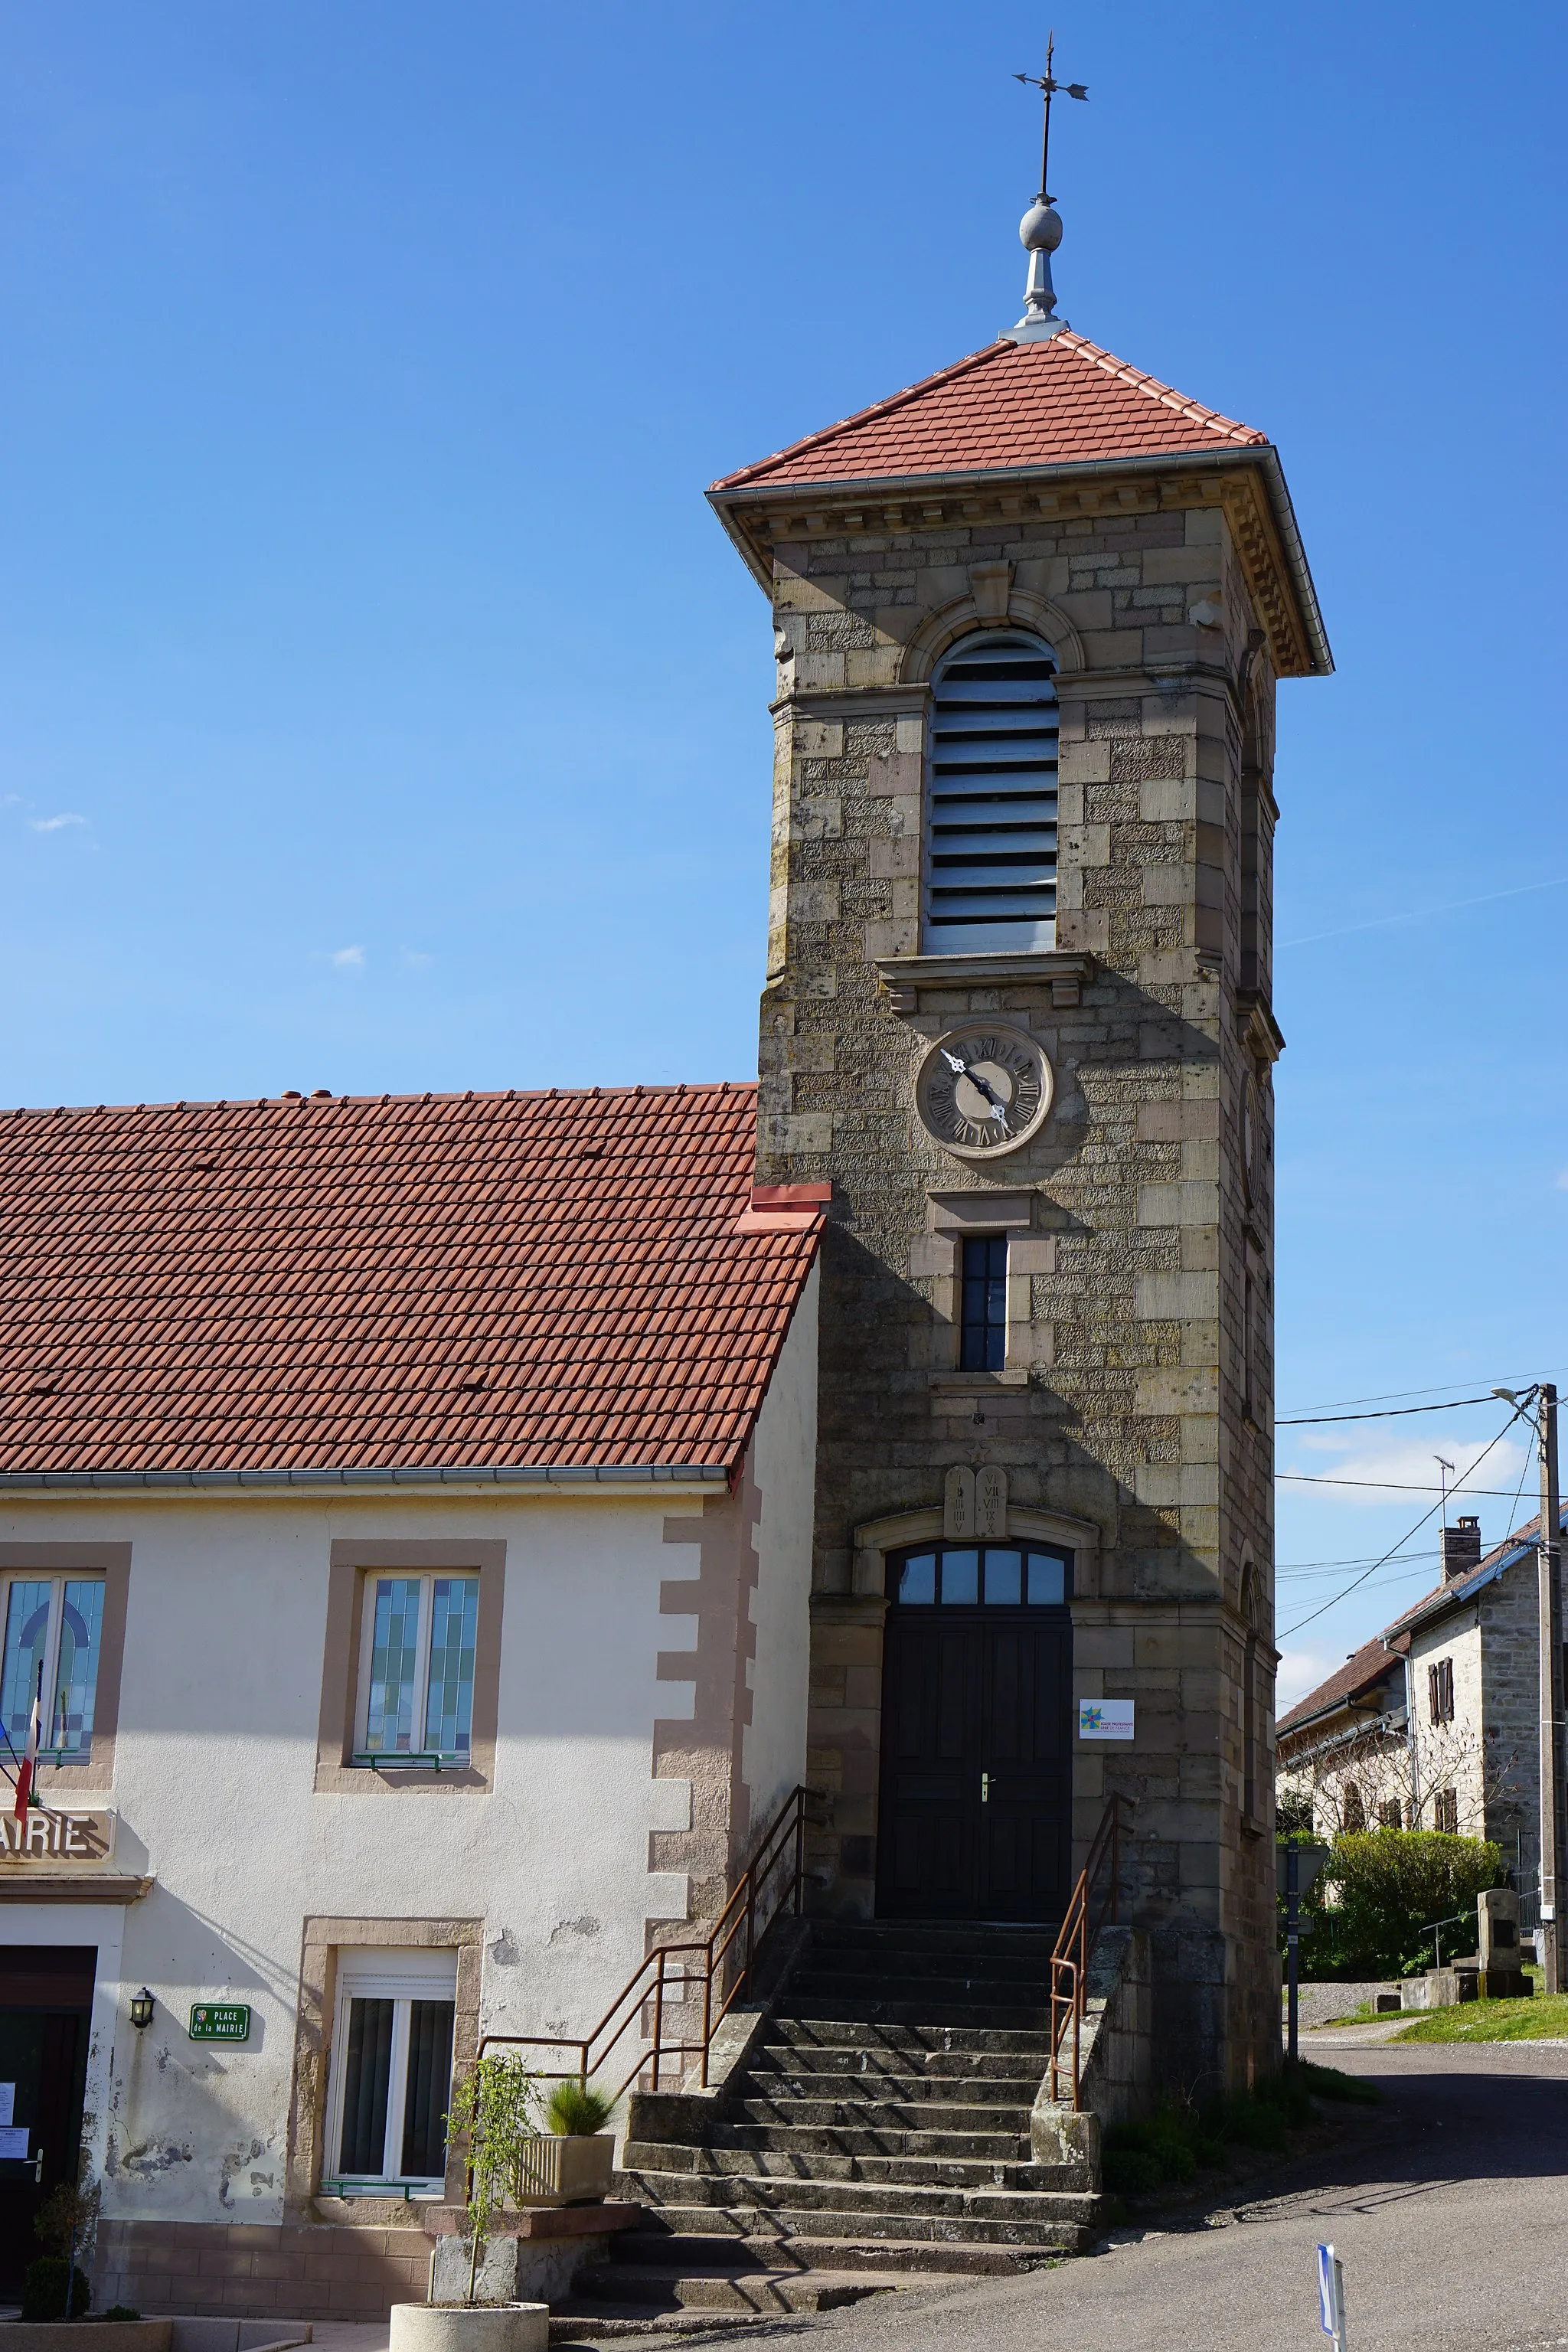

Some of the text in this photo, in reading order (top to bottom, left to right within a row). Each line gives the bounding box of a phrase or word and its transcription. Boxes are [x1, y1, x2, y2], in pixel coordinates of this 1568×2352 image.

[978, 1038, 998, 1058] XII
[1001, 1044, 1018, 1062] I
[929, 1085, 950, 1099] IX
[1018, 1081, 1039, 1096] III
[933, 1102, 953, 1127] VIII
[1013, 1101, 1036, 1121] IIII
[952, 1118, 969, 1142] VII
[976, 1125, 991, 1145] VI
[986, 1475, 997, 1484] VI
[985, 1486, 998, 1496] VII
[983, 1498, 999, 1508] VIII
[954, 1511, 965, 1521] IIII
[986, 1511, 995, 1521] IX
[956, 1523, 962, 1532] V
[987, 1522, 995, 1533] X
[214, 2011, 237, 2020] PLACE
[194, 2024, 243, 2033] de la MAIRIE
